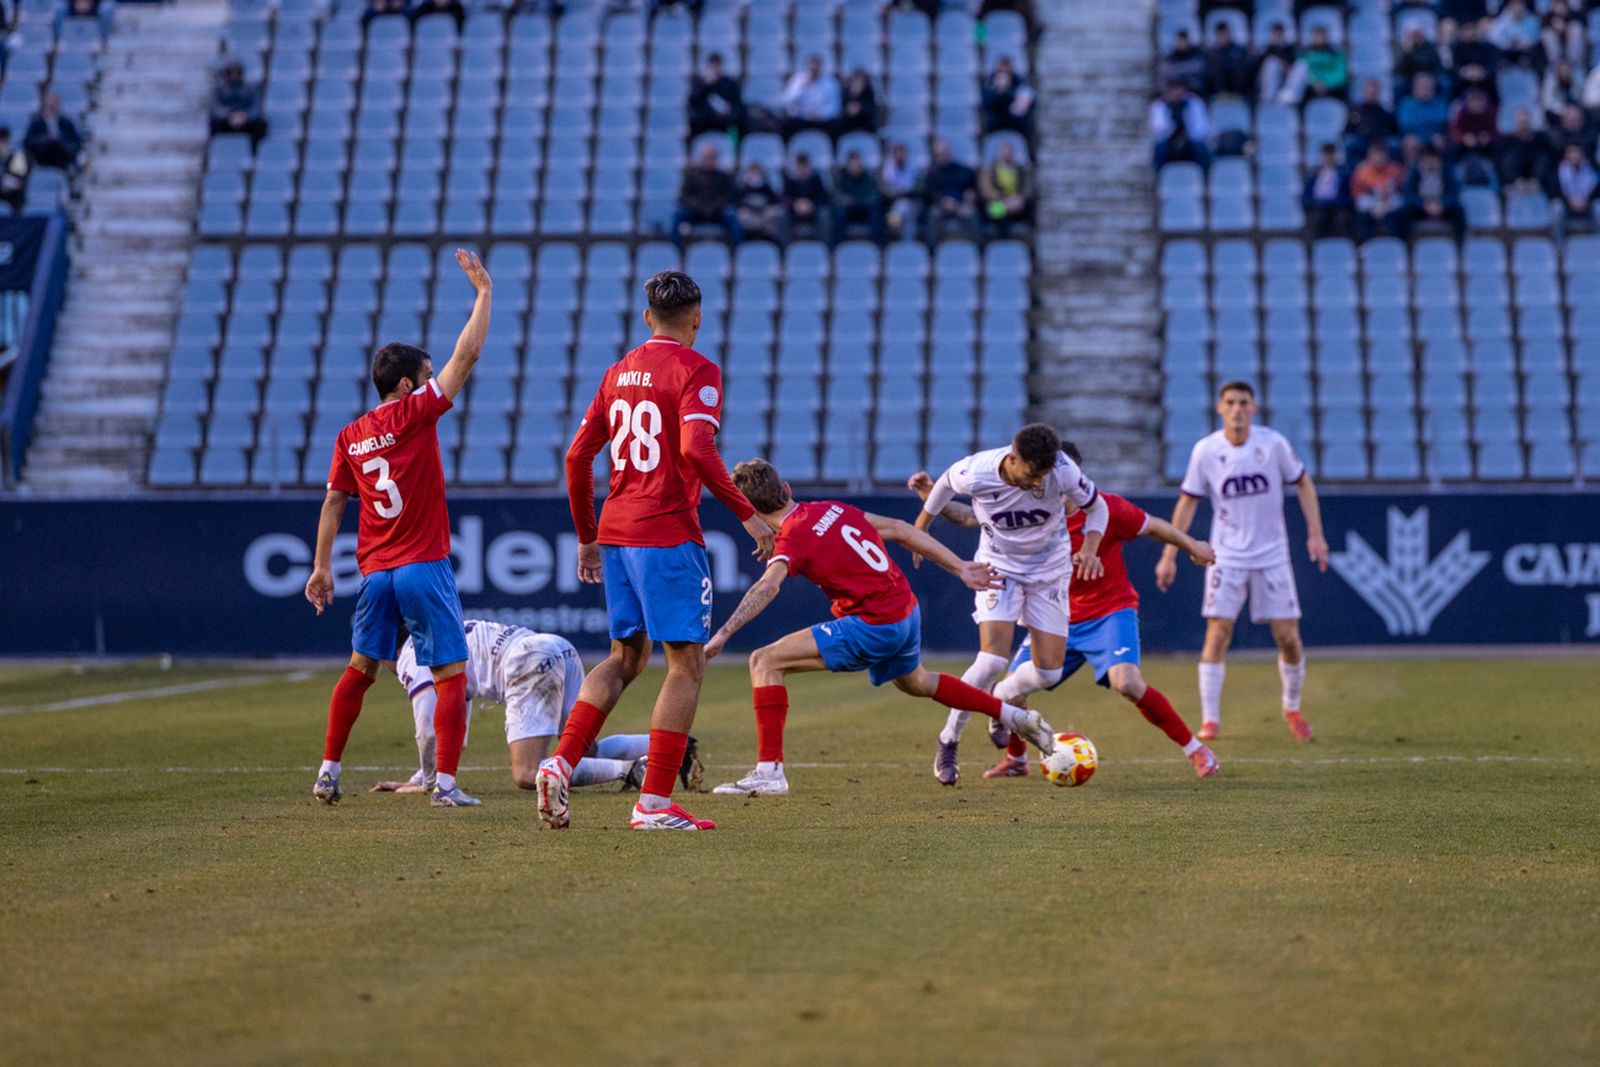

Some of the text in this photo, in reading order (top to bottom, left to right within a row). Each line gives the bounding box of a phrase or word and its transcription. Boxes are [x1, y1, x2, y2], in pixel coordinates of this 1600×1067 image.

[609, 399, 662, 472] 28
[362, 456, 403, 519] 3
[841, 524, 889, 572] 6
[700, 576, 713, 606] 2
